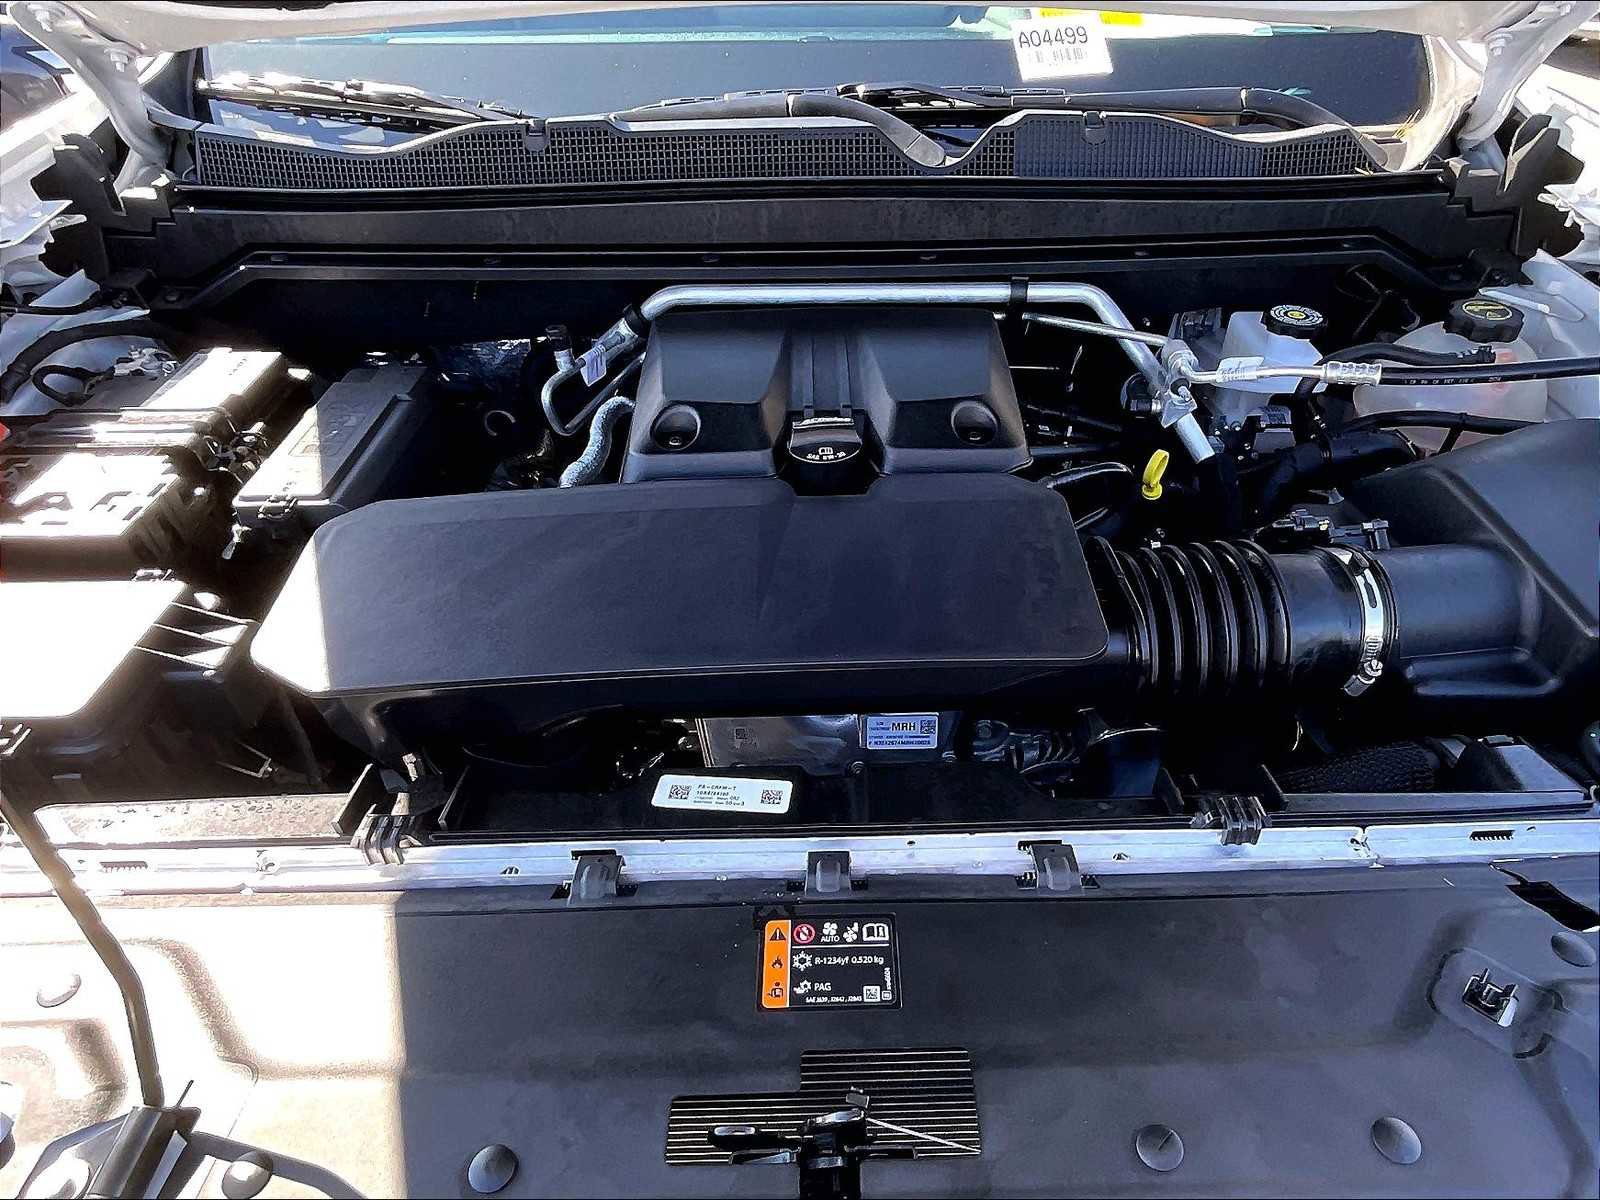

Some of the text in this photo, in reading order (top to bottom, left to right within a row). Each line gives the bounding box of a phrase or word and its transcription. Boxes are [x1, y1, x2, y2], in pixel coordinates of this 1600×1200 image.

[1019, 26, 1088, 48] A04499
[891, 722, 916, 731] MRH
[820, 935, 840, 943] AUTO
[814, 955, 885, 966] R-1234yf 0.520 kg
[814, 982, 832, 991] PAG
